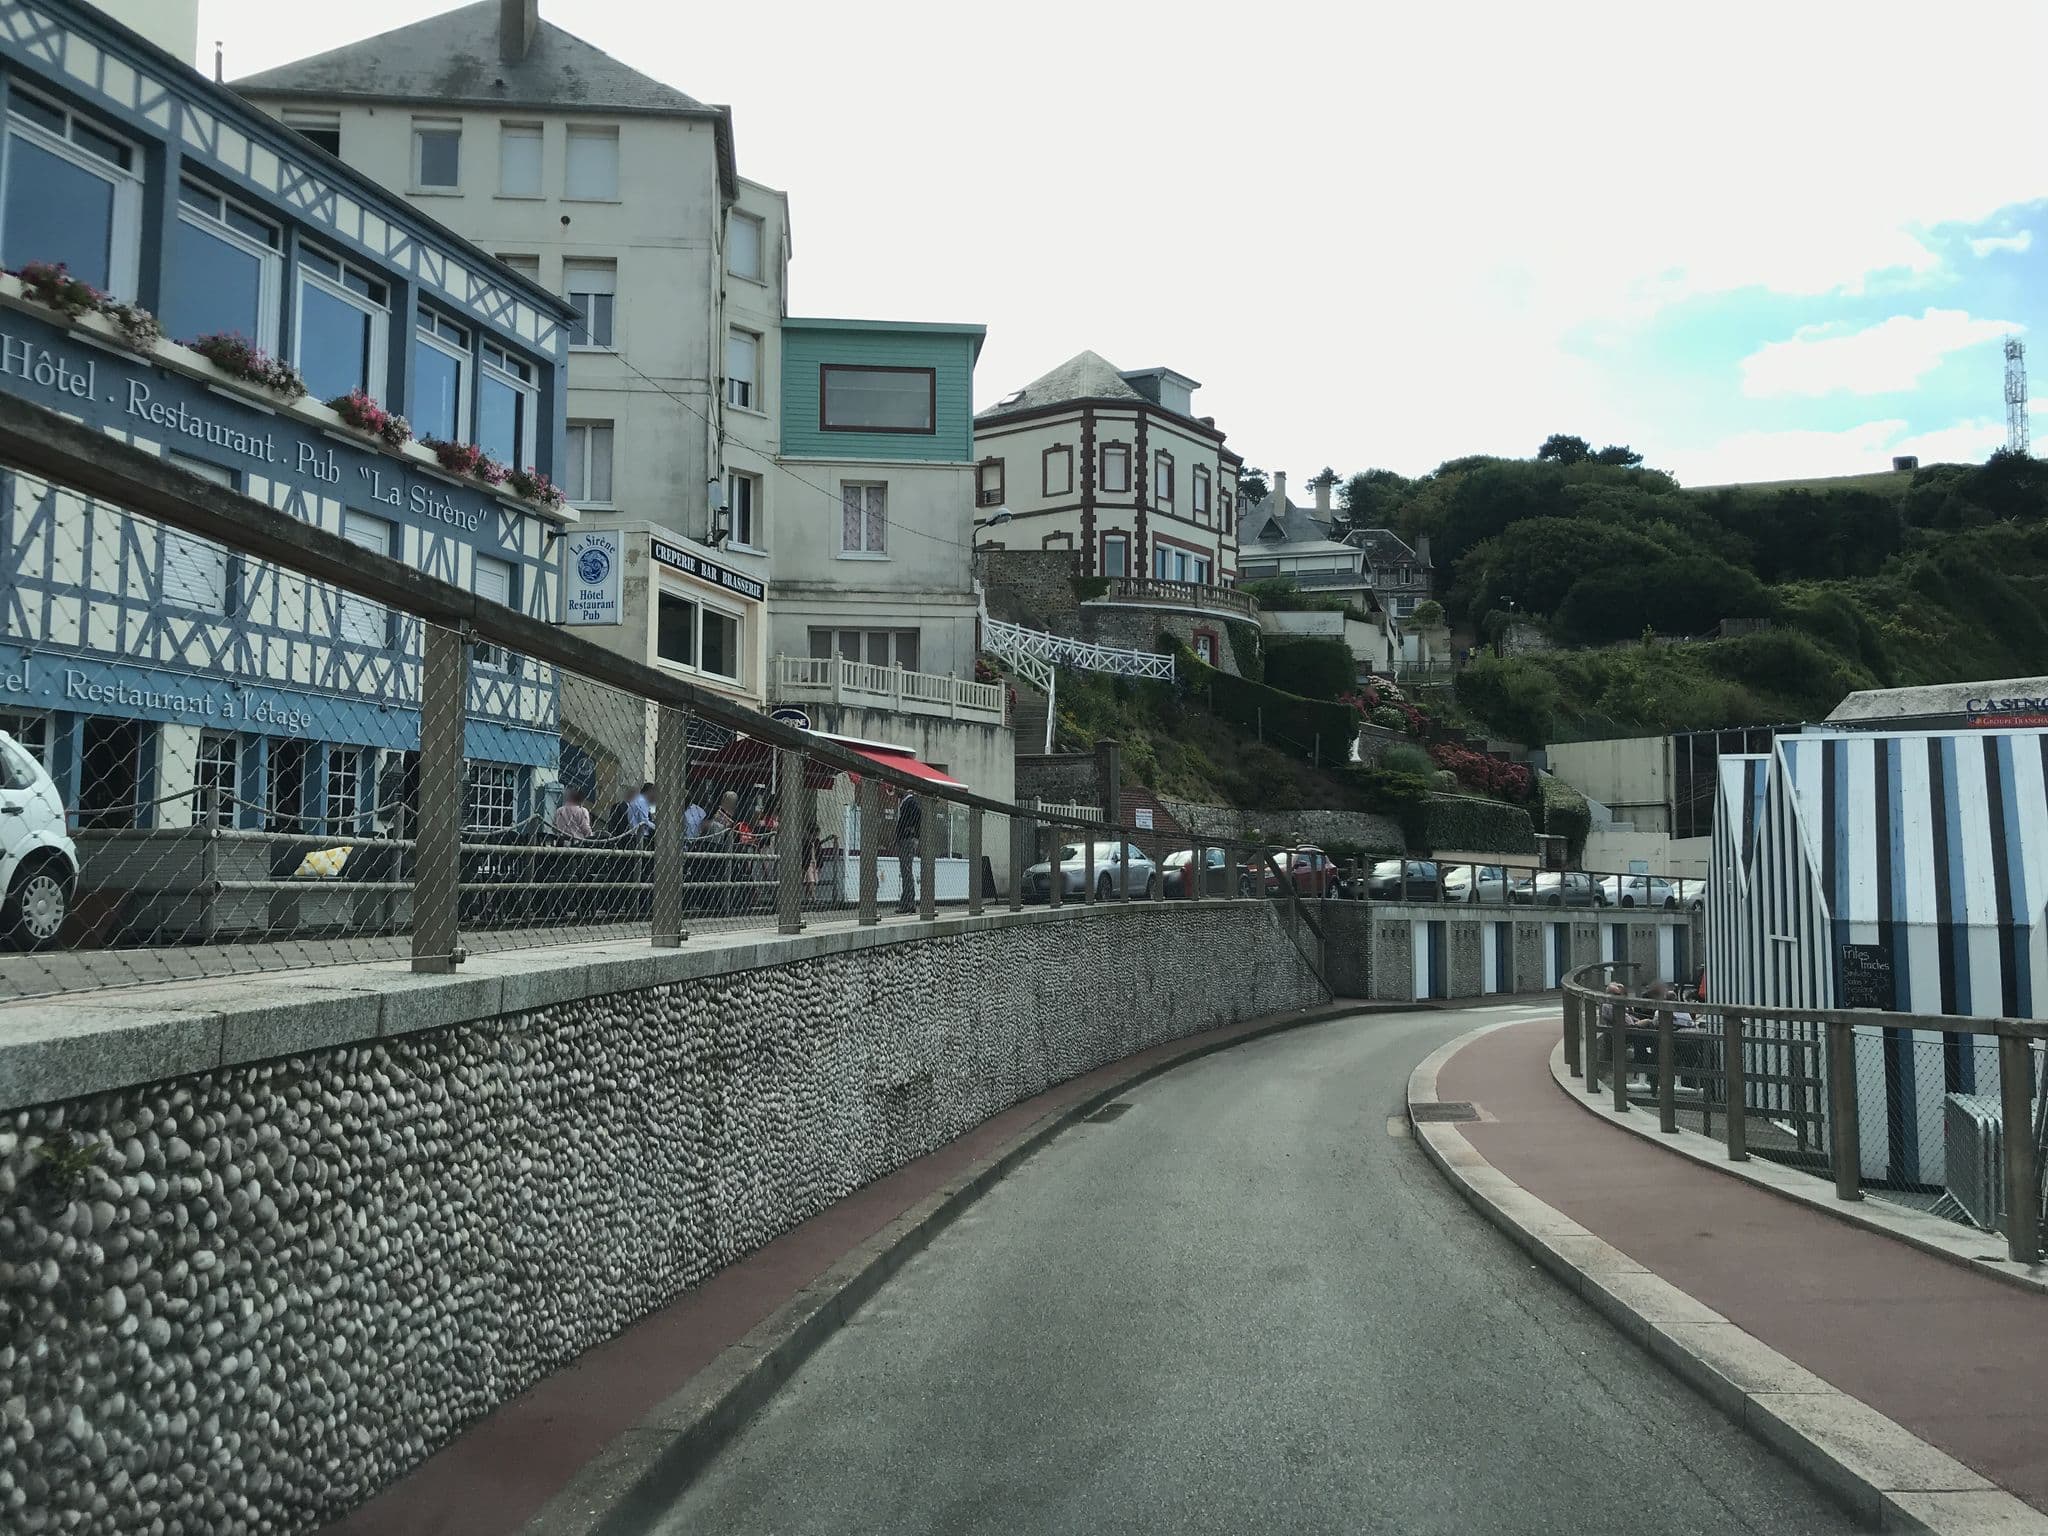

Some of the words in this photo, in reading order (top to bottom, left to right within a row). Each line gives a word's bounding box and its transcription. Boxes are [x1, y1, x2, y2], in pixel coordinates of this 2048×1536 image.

[0, 333, 96, 400] Hôtel
[125, 377, 275, 463] Restaurant
[296, 441, 340, 484] Pub
[569, 543, 584, 556] La
[585, 534, 616, 554] Sirène
[655, 543, 696, 573] CREPERIE
[701, 562, 718, 581] BAR
[722, 571, 762, 598] BRASSERIE
[568, 599, 615, 611] Restaurant
[580, 589, 604, 600] Hôtel
[582, 610, 600, 621] Pub
[64, 668, 215, 716] Restaurant
[222, 693, 236, 719] à
